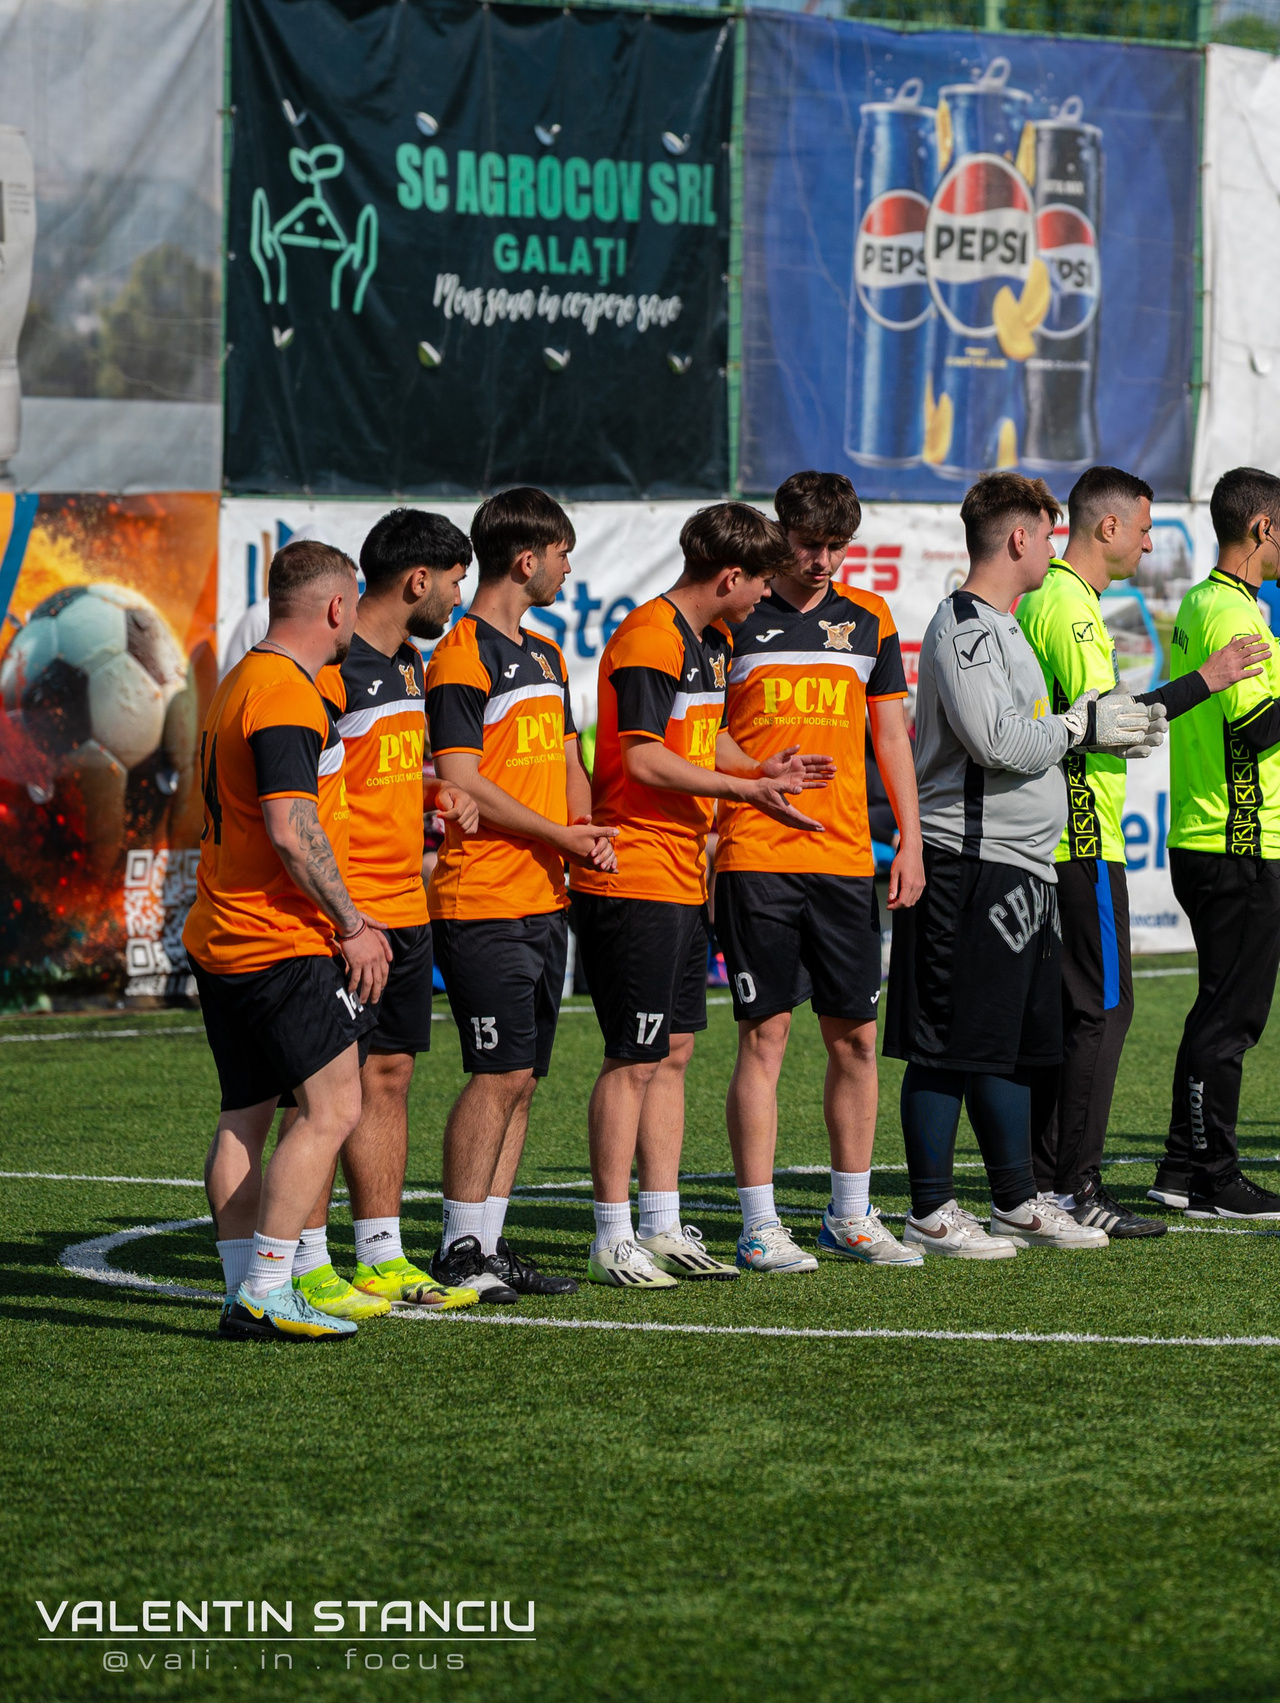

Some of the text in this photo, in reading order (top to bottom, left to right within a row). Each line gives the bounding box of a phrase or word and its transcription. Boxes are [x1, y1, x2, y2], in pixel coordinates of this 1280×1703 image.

[395, 142, 718, 227] SC AGROCOV SRL
[934, 223, 1029, 267] PEPSI
[761, 677, 850, 716] PCM
[515, 711, 565, 754] PCM
[753, 716, 802, 727] CONSTRUCT
[803, 717, 838, 727] MODERN
[470, 1016, 499, 1050] 13
[635, 1011, 664, 1045] 17
[1187, 1075, 1208, 1150] Joma
